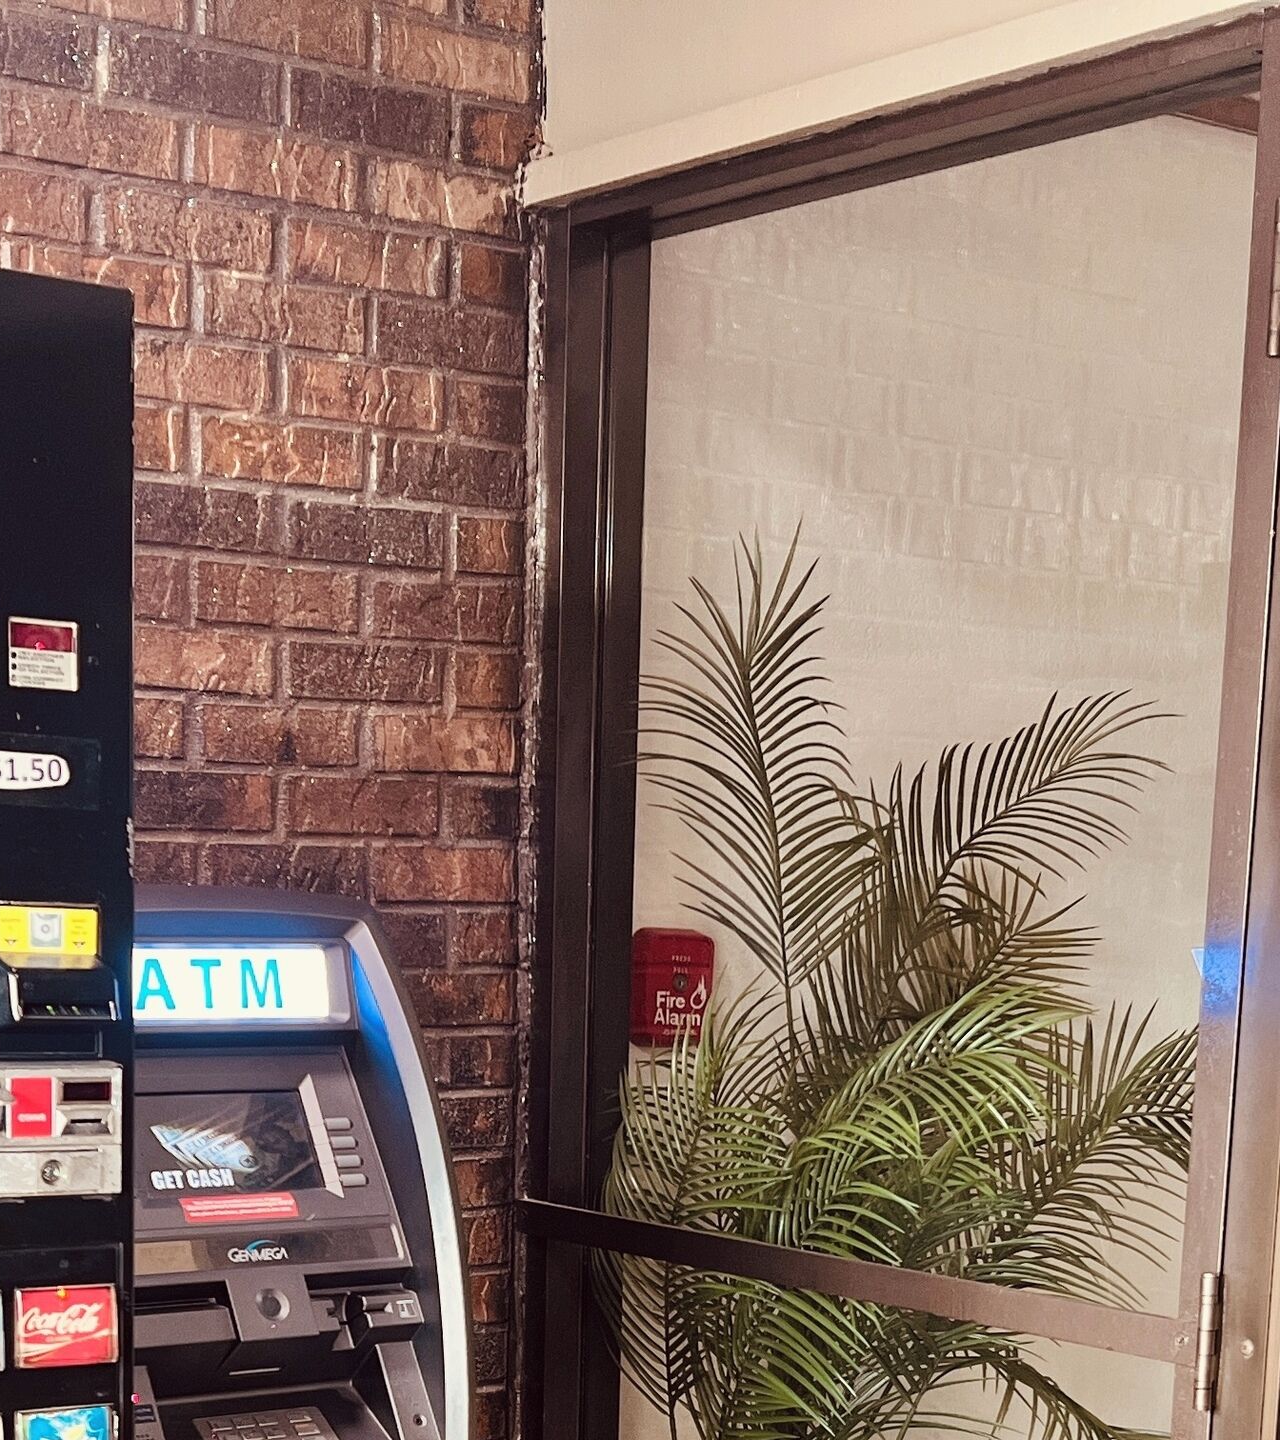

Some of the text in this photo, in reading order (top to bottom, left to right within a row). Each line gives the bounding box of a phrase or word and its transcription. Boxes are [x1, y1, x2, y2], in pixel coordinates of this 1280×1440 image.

[135, 958, 283, 1010] ATM
[656, 990, 686, 1009] Fire
[653, 1008, 701, 1026] Alarm
[150, 1167, 235, 1191] GET CASH
[227, 1246, 289, 1263] GENMEGA
